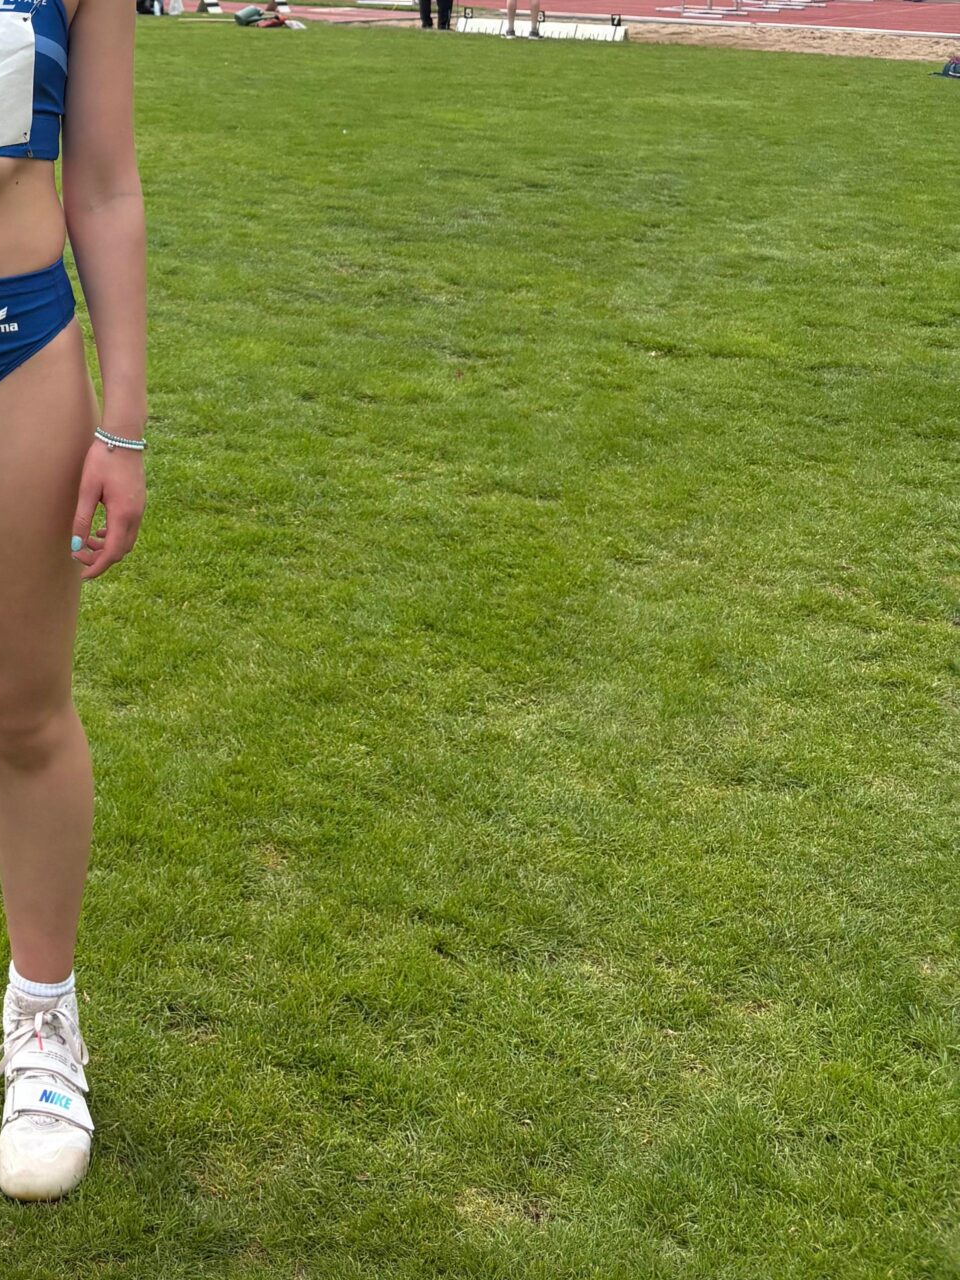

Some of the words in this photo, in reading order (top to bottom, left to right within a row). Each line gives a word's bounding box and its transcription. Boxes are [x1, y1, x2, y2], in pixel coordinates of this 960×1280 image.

[465, 8, 472, 17] 5
[612, 15, 619, 24] 7
[39, 1089, 72, 1110] NIKE
